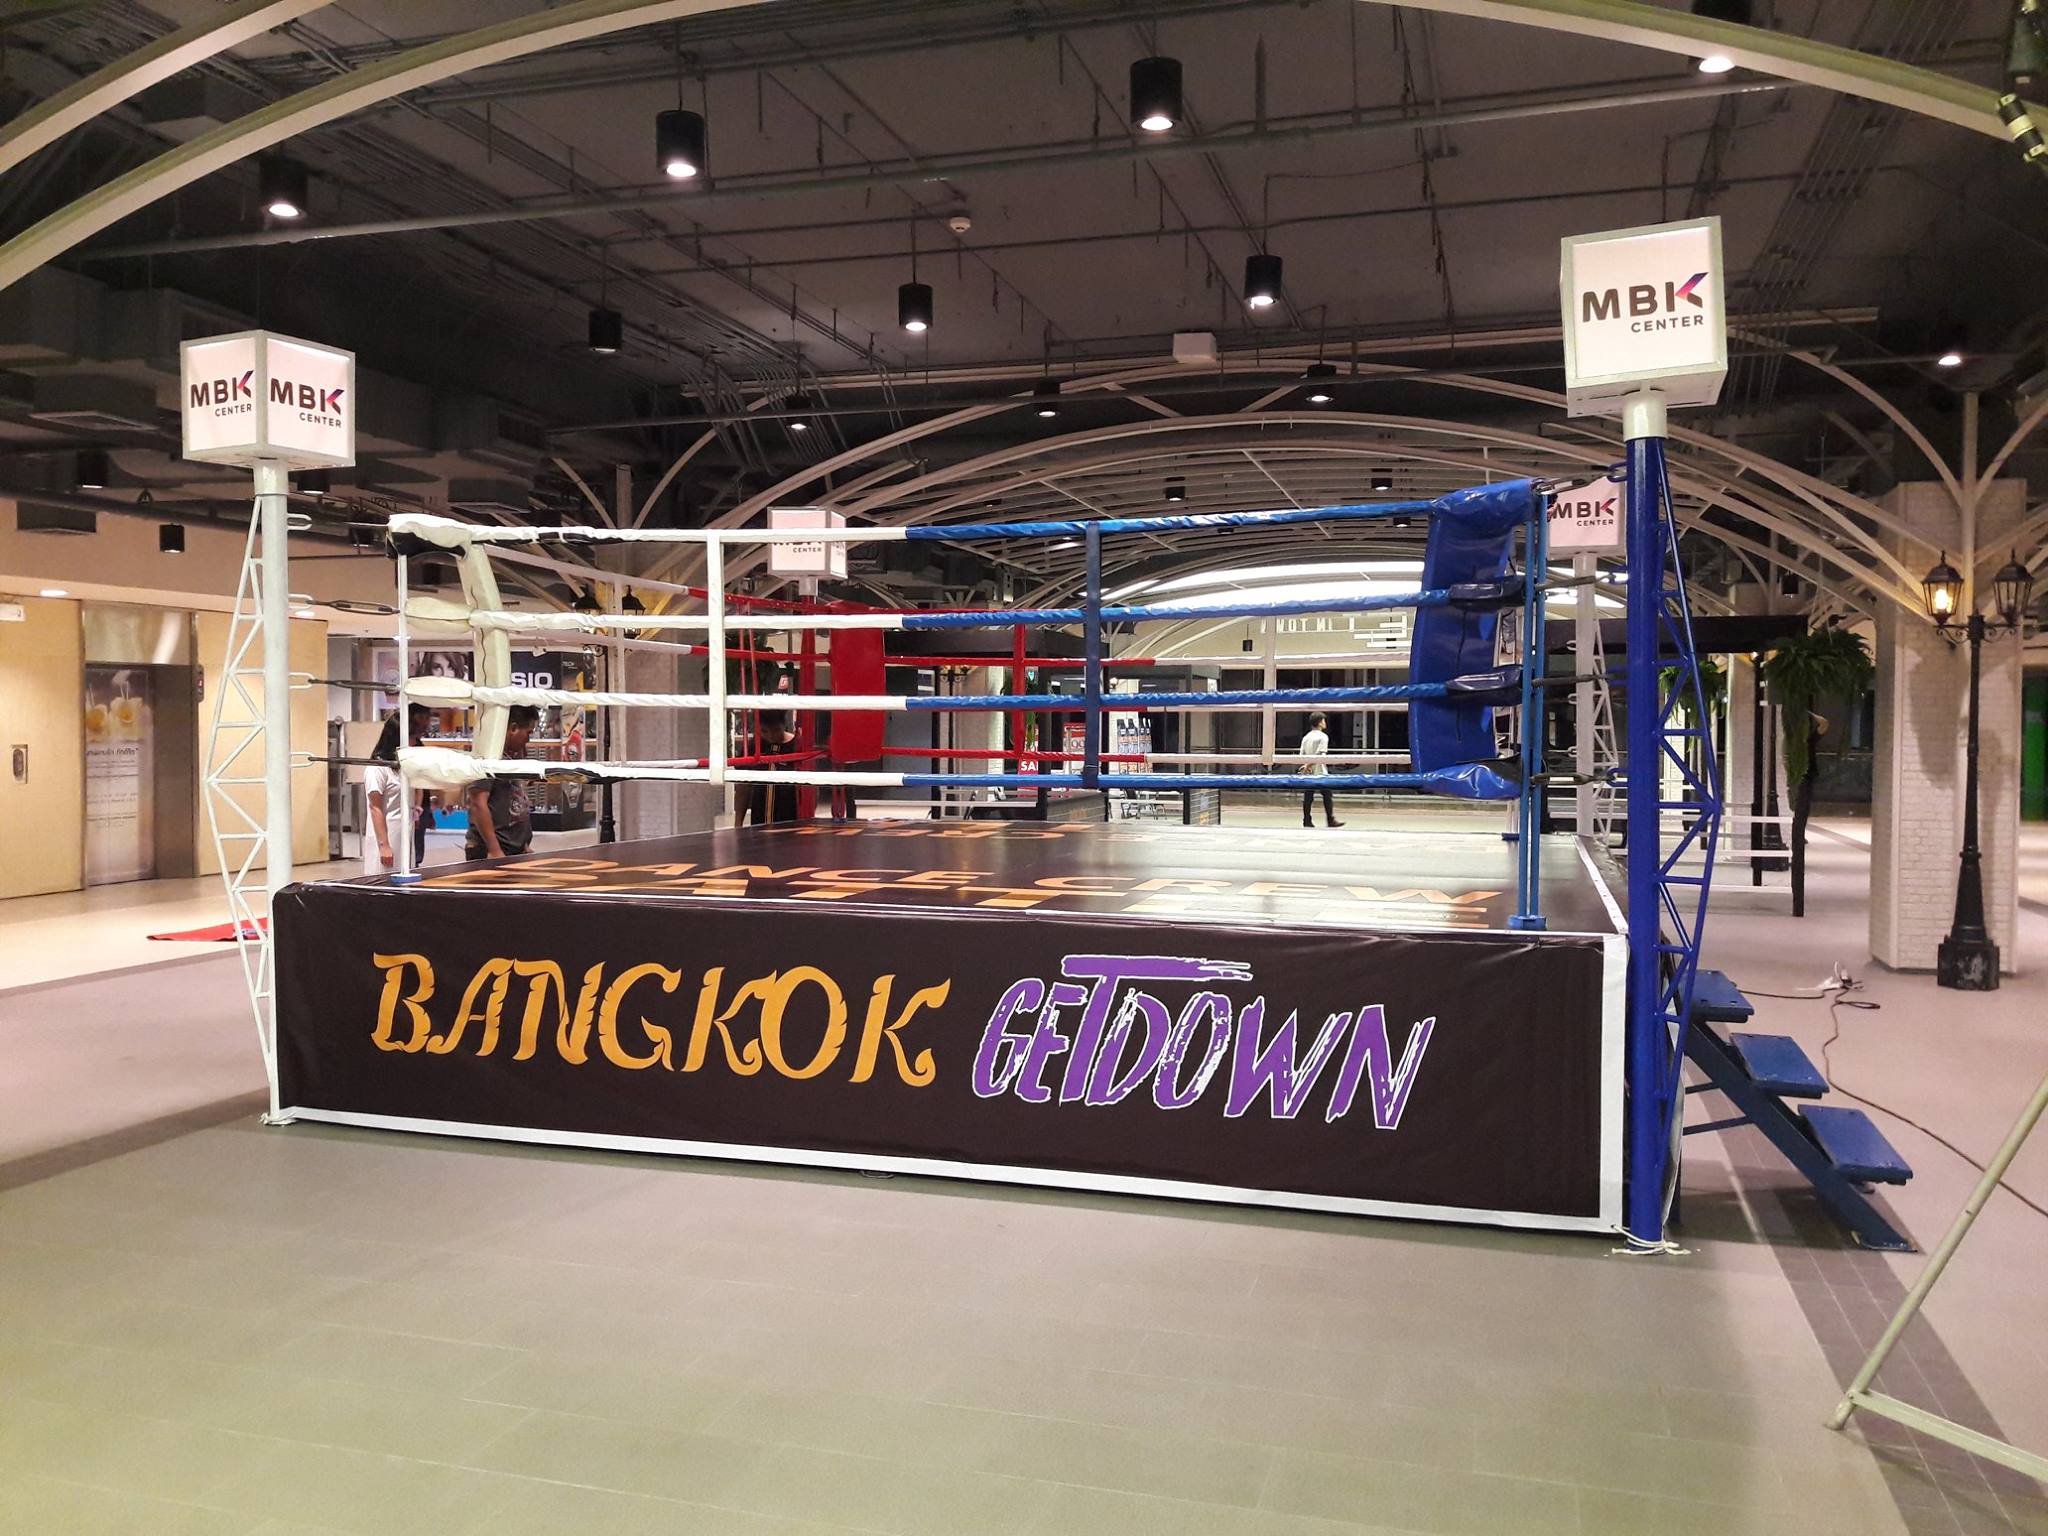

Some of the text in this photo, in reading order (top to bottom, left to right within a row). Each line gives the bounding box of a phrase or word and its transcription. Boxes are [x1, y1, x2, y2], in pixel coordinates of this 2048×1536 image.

[1582, 272, 1709, 322] MBK
[1630, 315, 1704, 333] CENTER
[190, 370, 254, 408] MBK
[270, 378, 345, 415] MBK
[214, 403, 252, 417] CENTER
[299, 412, 342, 428] CENTER
[1552, 497, 1618, 519] MBK
[1576, 519, 1614, 527] CENTER
[511, 672, 553, 688] SIO
[496, 857, 1503, 904] DANCE CREW
[371, 952, 1436, 1129] BANGKOK GETDOWN
